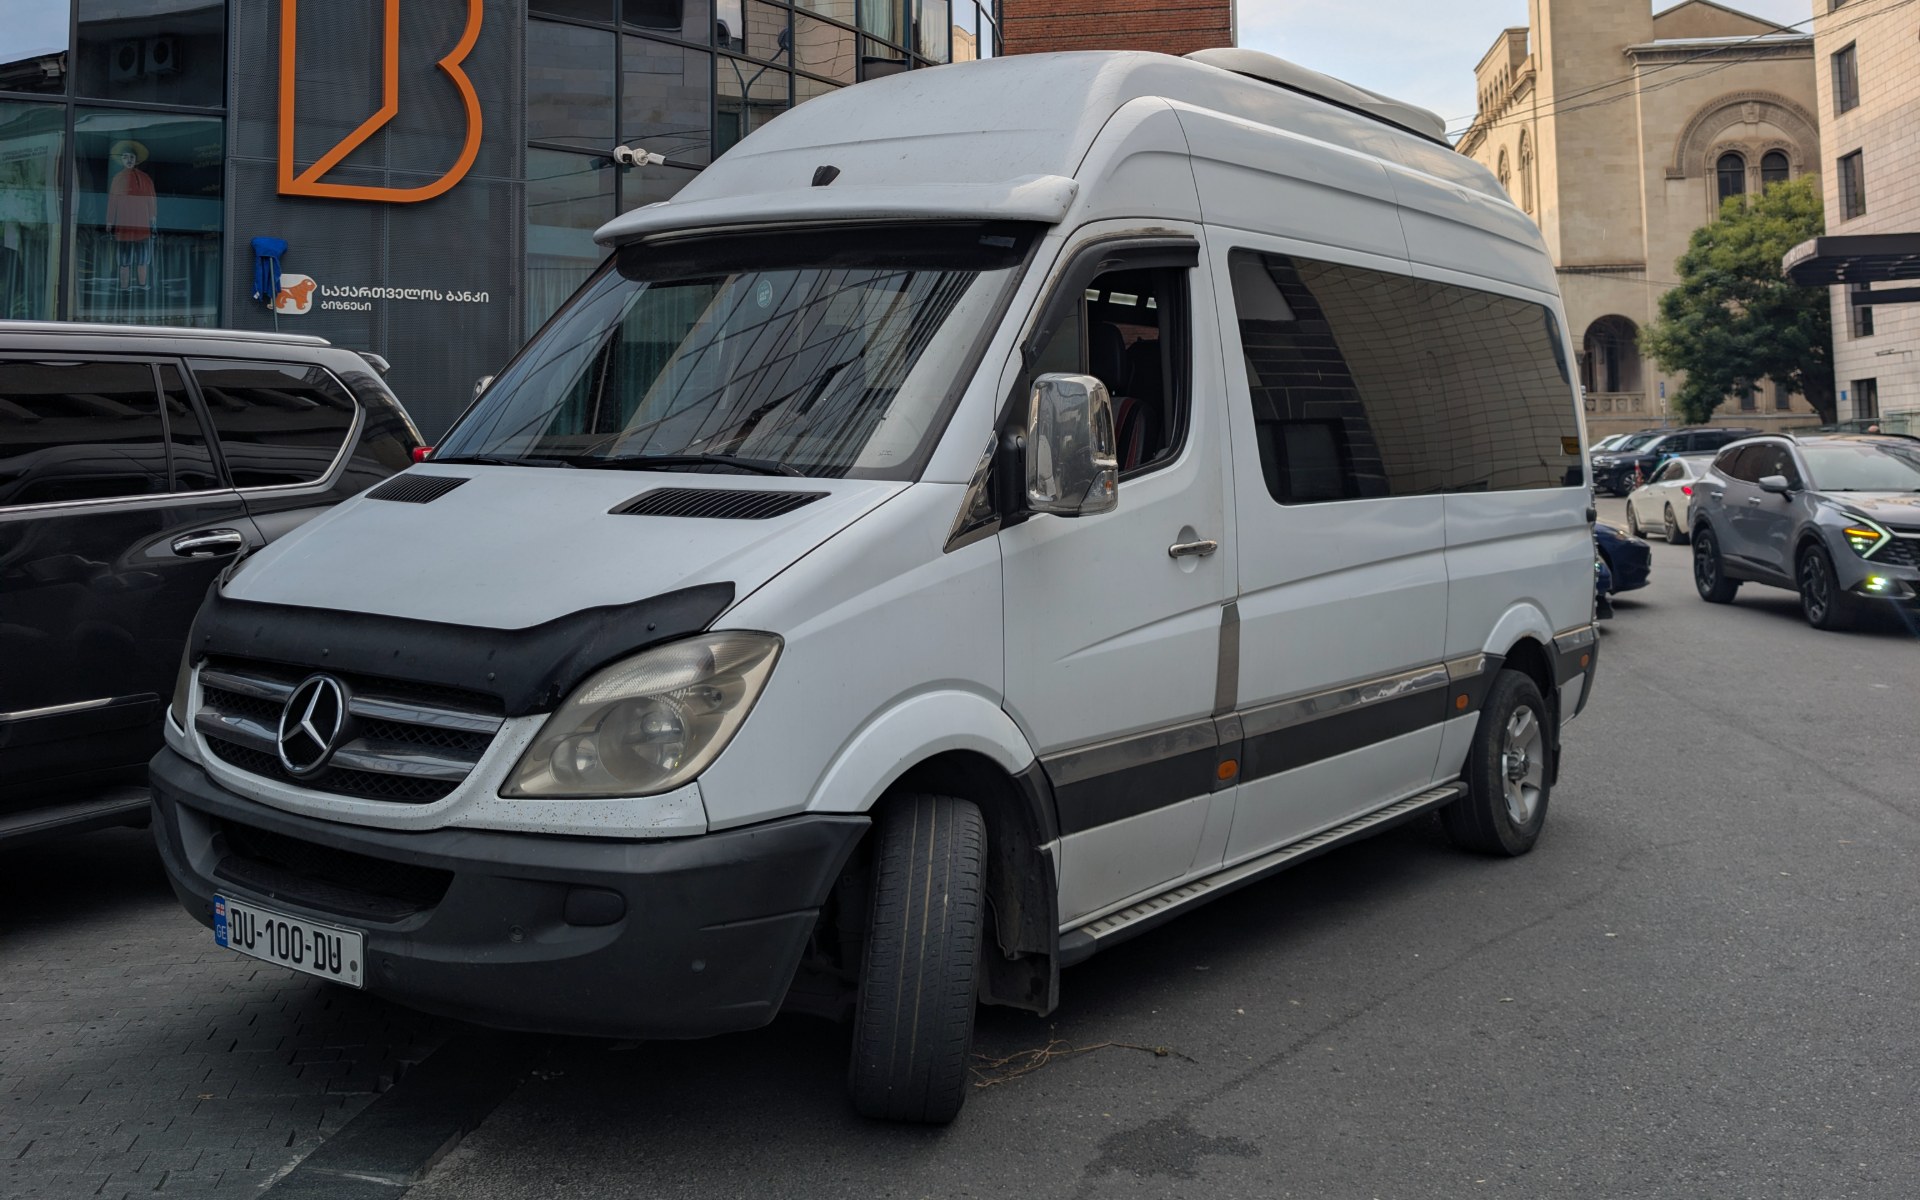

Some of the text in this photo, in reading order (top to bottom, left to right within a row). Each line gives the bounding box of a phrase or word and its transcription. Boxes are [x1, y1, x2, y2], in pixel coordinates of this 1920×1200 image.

[321, 285, 490, 303] საქართველოს ბანკი
[321, 301, 371, 311] ბიზნესი
[216, 924, 227, 940] GE
[231, 908, 342, 974] DU-100-DU
